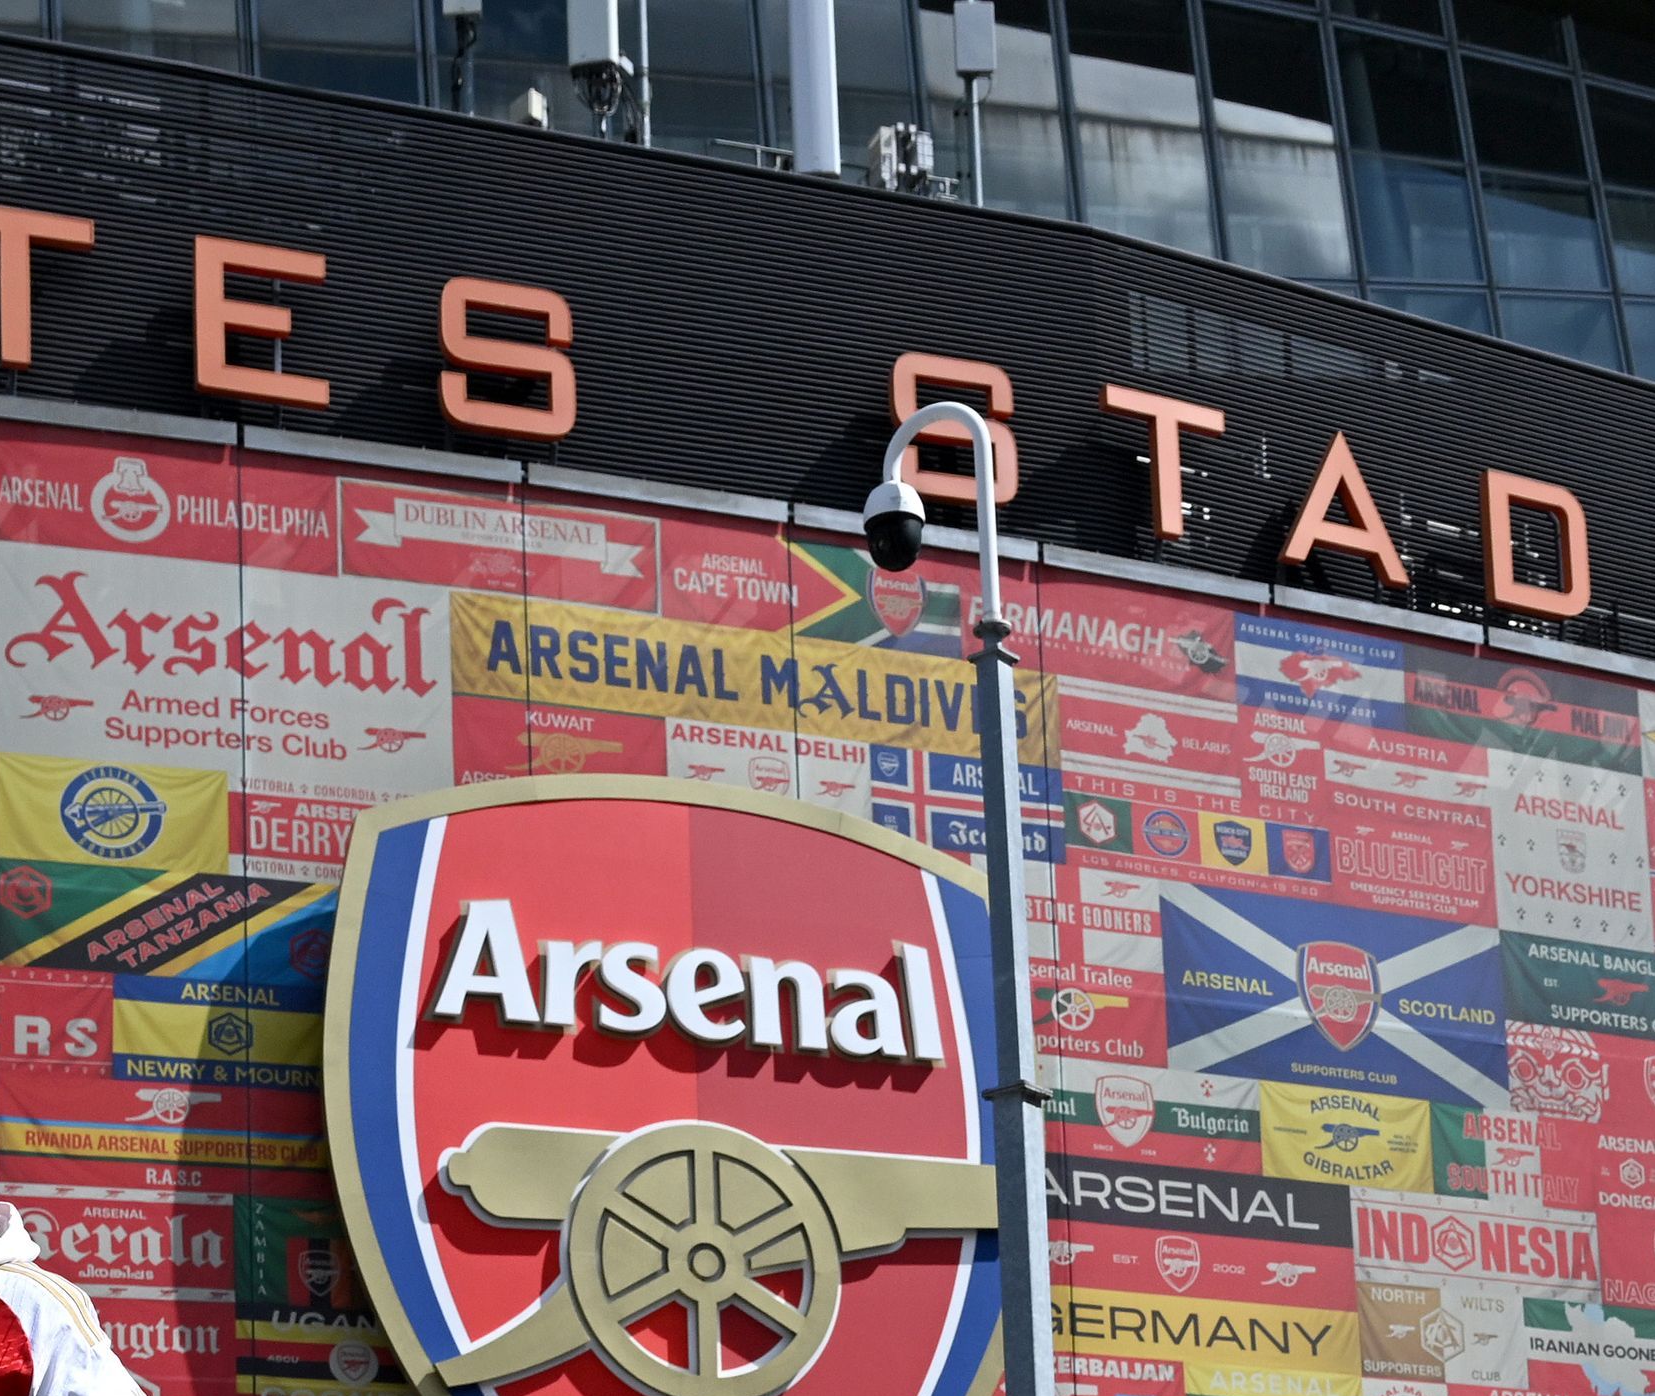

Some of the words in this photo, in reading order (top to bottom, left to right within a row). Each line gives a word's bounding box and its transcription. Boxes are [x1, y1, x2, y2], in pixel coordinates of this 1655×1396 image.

[176, 492, 330, 539] PHILADELPHIA
[403, 502, 487, 530] DUBLIN
[493, 513, 599, 547] ARSENAL
[674, 567, 727, 597] CAPE
[734, 578, 798, 606] TOWN
[5, 570, 437, 698] Arsenal
[487, 619, 738, 701] ARSENAL
[122, 690, 218, 720] Armed
[229, 700, 330, 730] Forces
[525, 711, 594, 732] KUWAIT
[105, 716, 274, 752] Supporters
[282, 732, 347, 761] Club
[671, 724, 787, 753] ARSENAL
[797, 739, 866, 763] DELHI
[1066, 718, 1118, 737] ARSENAL
[1182, 738, 1231, 755] BELARUS
[1368, 737, 1447, 763] AUSTRIA
[1075, 775, 1136, 796] THIS
[1152, 785, 1177, 802] IS
[1196, 793, 1241, 813] THE
[1259, 803, 1315, 823] CITY
[1259, 782, 1309, 802] IRELAND
[1334, 791, 1395, 815] SOUTH
[1402, 801, 1486, 827] CENTRAL
[1336, 836, 1486, 893] BLUELIGHT
[1506, 871, 1643, 912] YORKSHIRE
[116, 881, 270, 970] TANZANIA
[1528, 944, 1601, 967] ARSENAL
[431, 898, 946, 1068] Arsenal
[1182, 969, 1273, 996] ARSENAL
[1399, 999, 1495, 1025] SCOTLAND
[146, 1168, 202, 1187] R.A.S.C
[1529, 1335, 1599, 1357] IRANIAN
